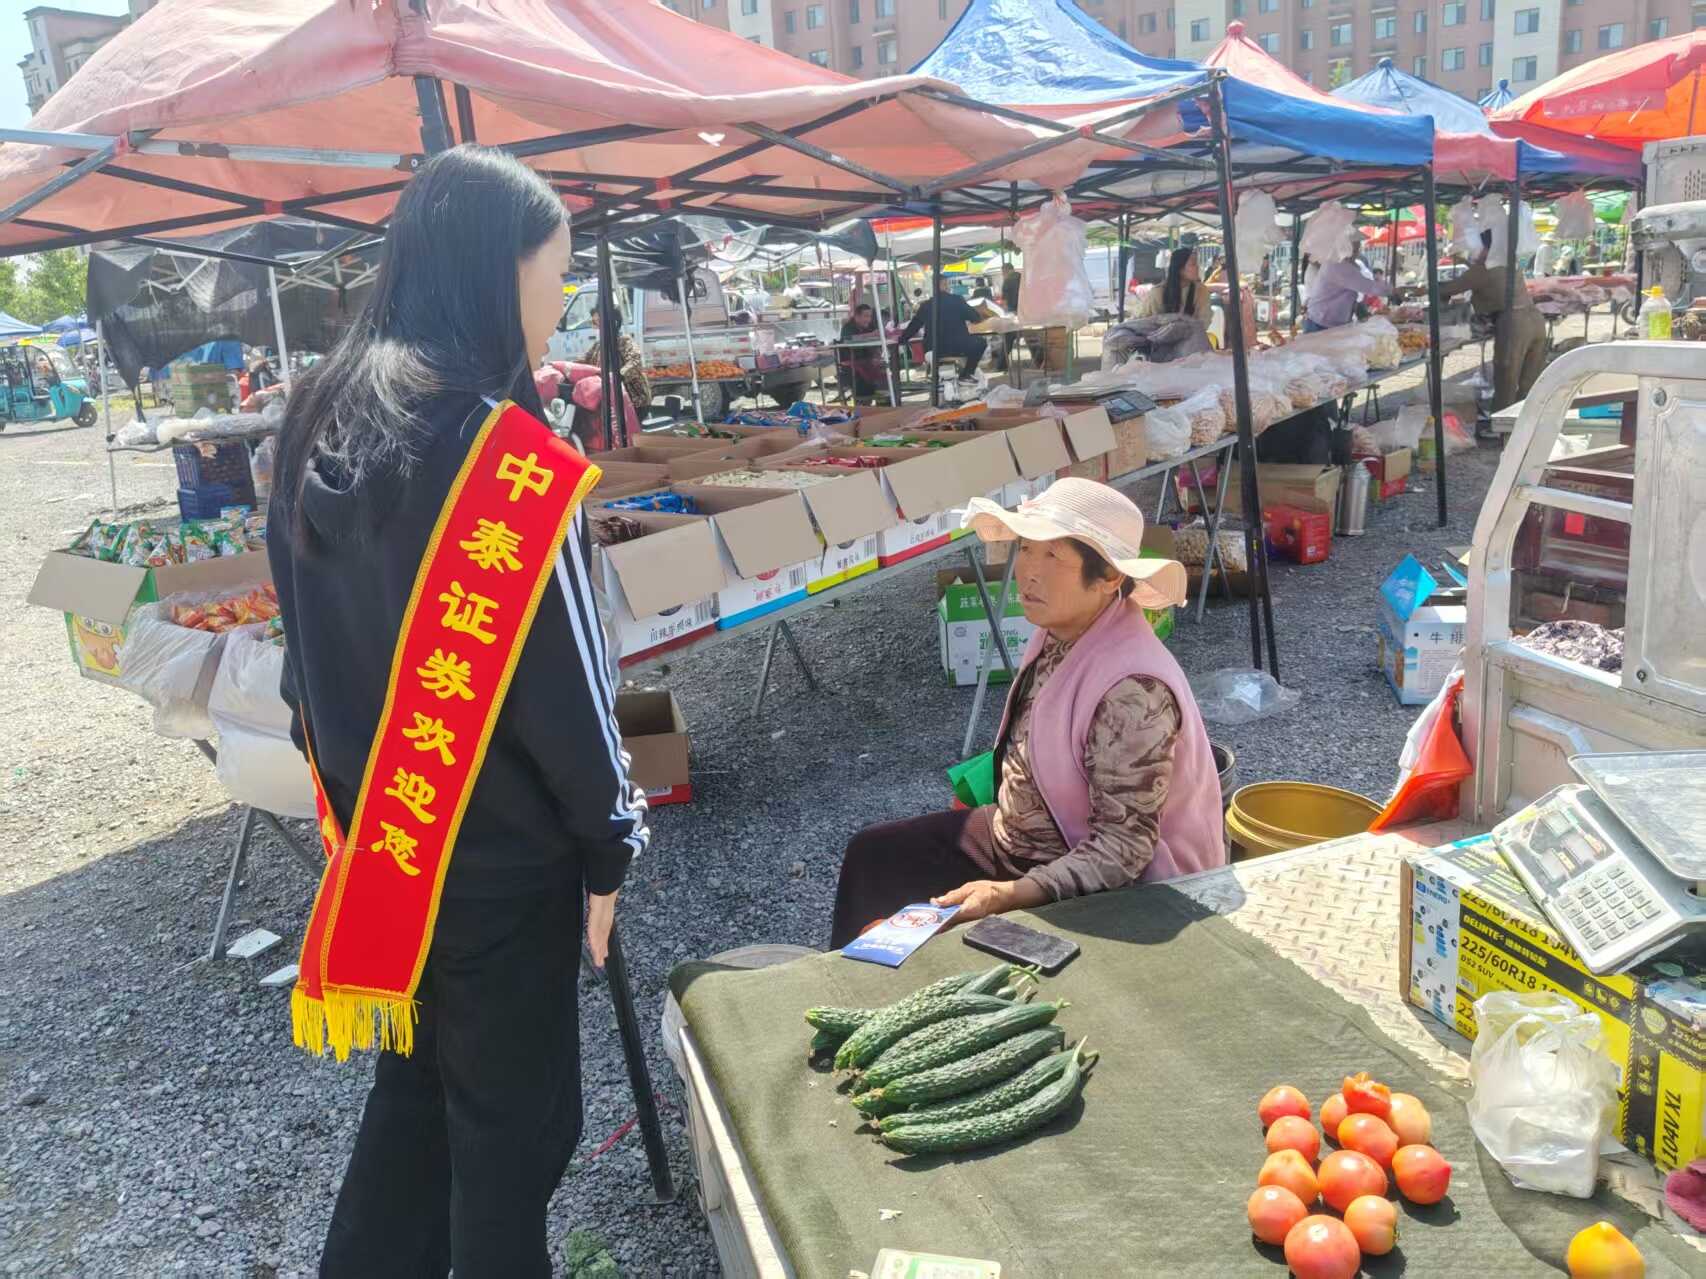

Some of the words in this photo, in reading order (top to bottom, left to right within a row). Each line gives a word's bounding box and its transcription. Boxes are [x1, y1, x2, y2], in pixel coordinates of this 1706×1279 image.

[371, 452, 554, 876] 中泰证券欢迎您
[1461, 935, 1537, 989] 225/60R18
[1478, 963, 1495, 978] SUV
[1665, 1089, 1682, 1116] XL
[1662, 1111, 1680, 1165] 104V
